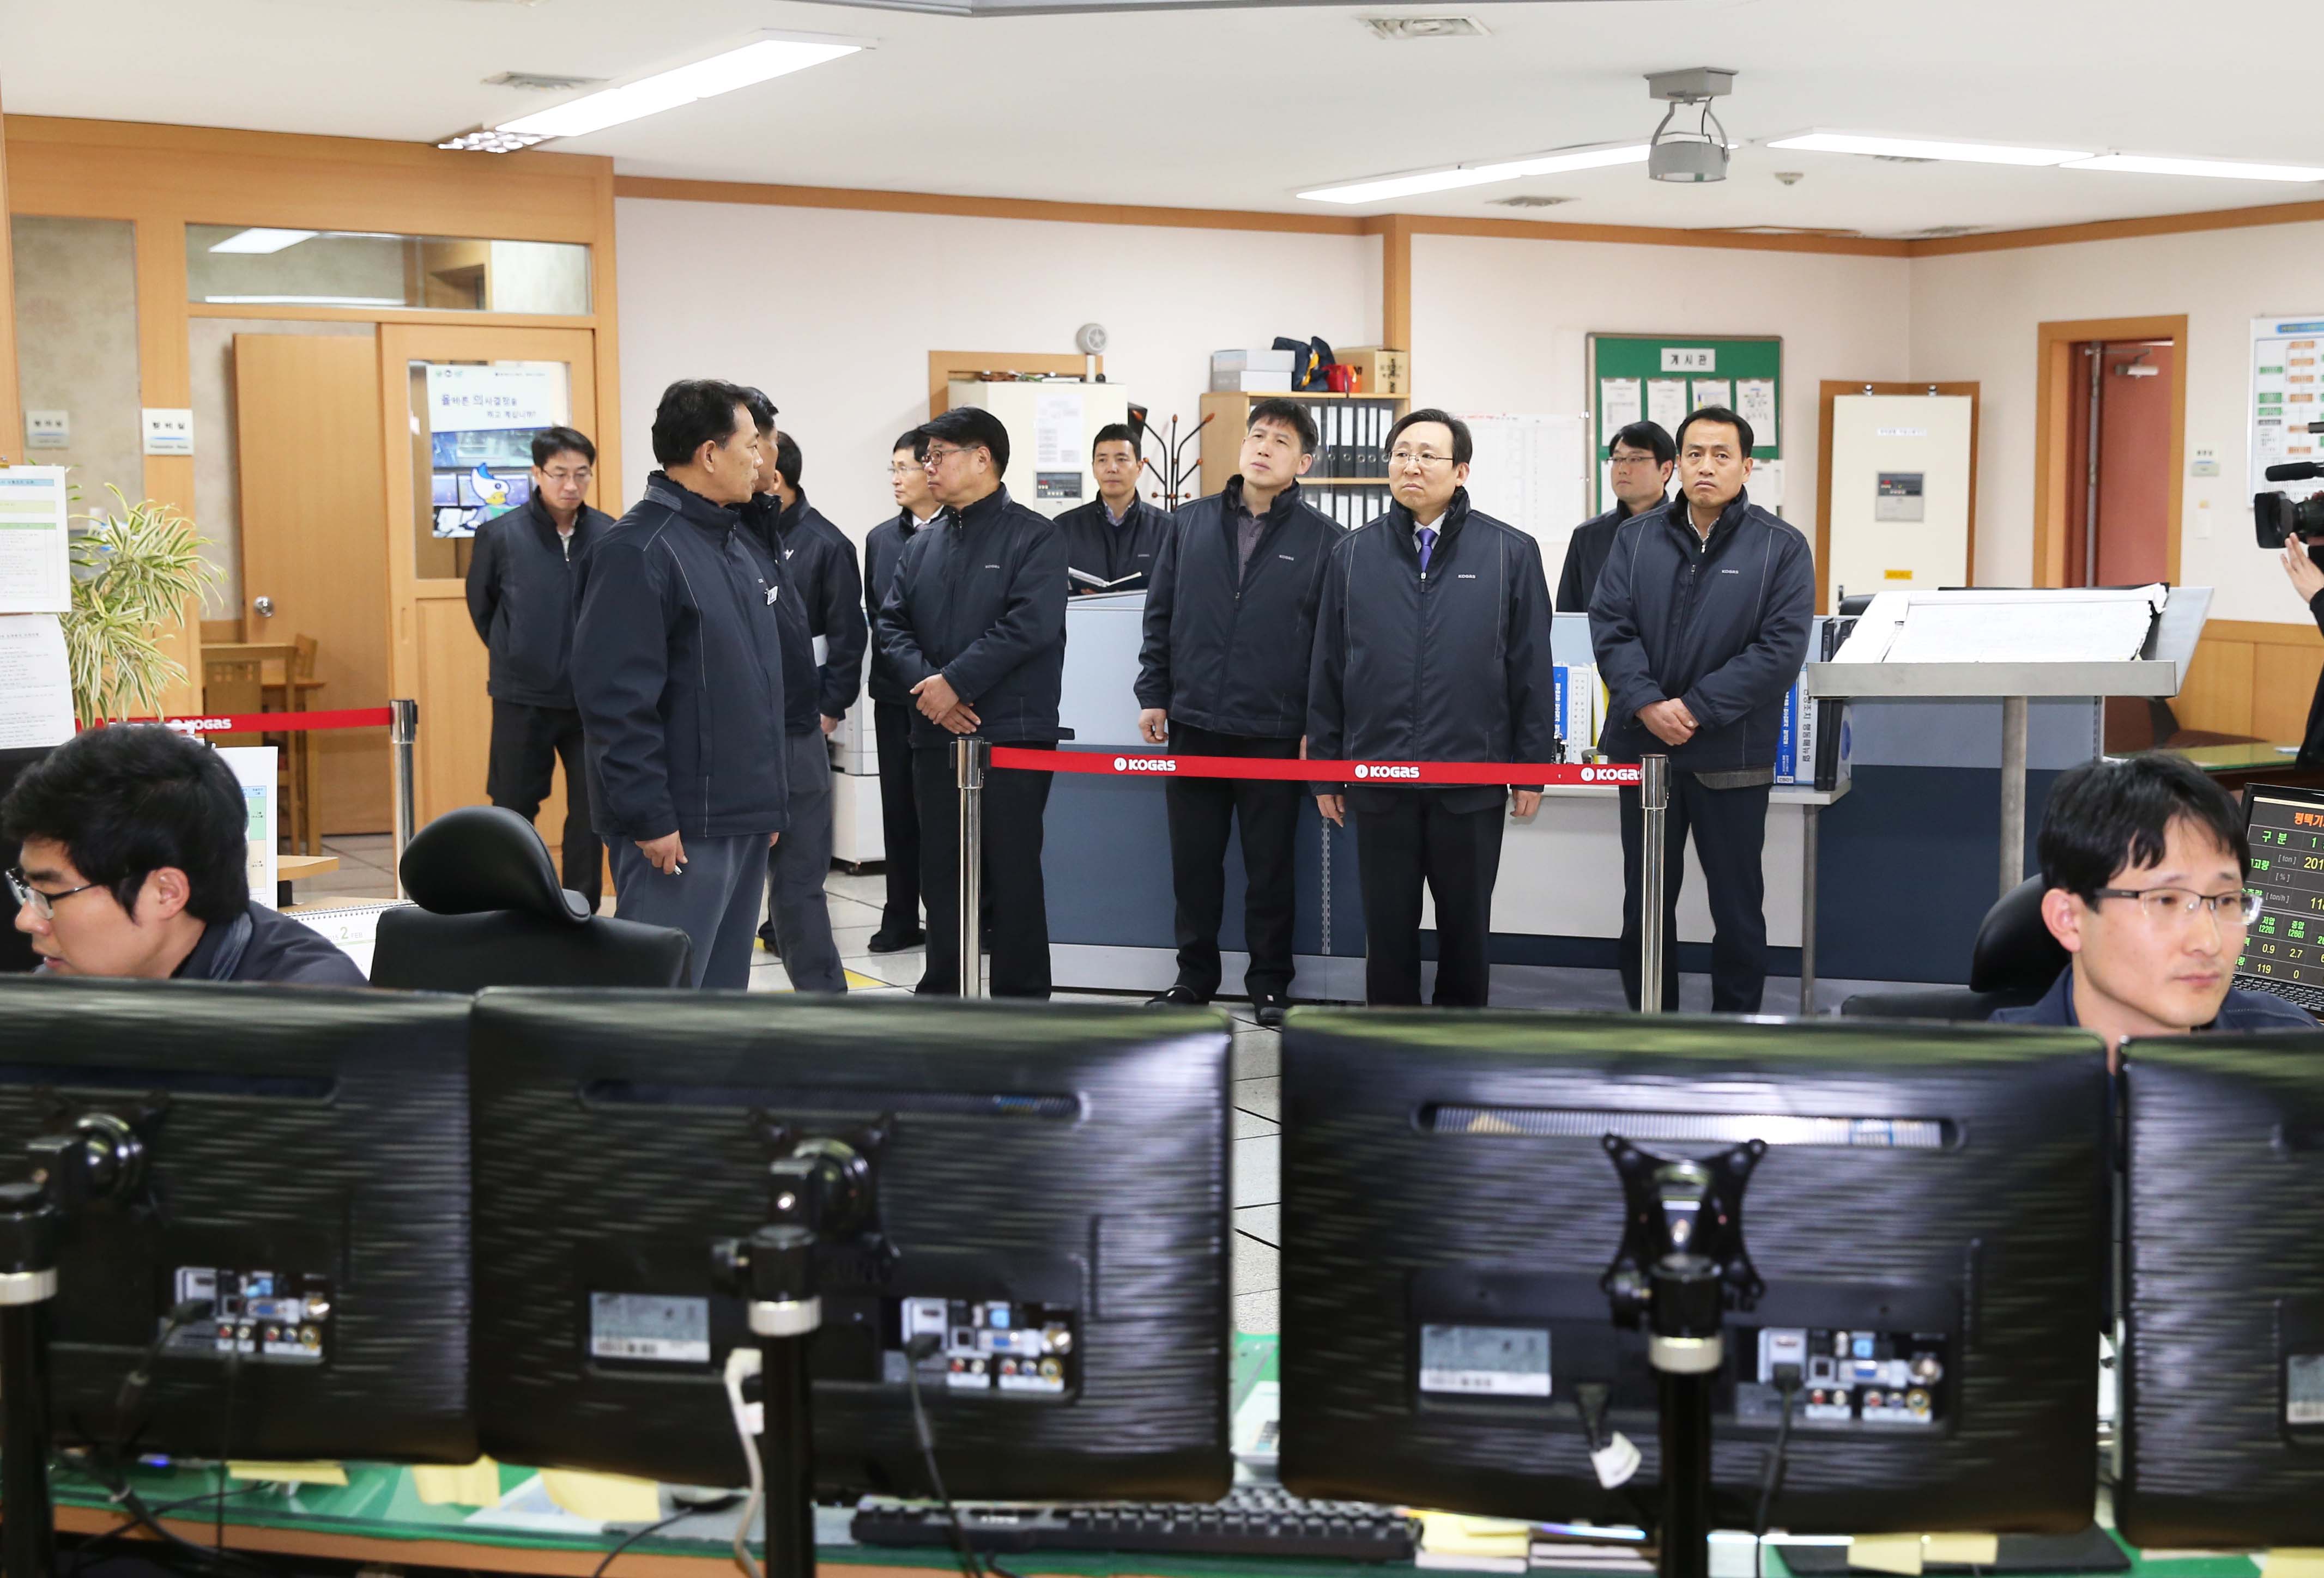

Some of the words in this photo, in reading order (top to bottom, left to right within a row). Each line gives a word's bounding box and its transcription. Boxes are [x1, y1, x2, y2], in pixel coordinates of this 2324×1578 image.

[1596, 768, 1640, 780] KOGA
[2294, 812, 2324, 828] 평택기
[2250, 858, 2270, 871] 고량
[2262, 916, 2275, 926] 저압
[2291, 920, 2305, 930] 중압
[340, 926, 349, 940] 2
[2262, 944, 2275, 954] 0.9
[2289, 948, 2303, 958] 2.7
[2257, 963, 2272, 974] 119
[2293, 970, 2299, 979] 0
